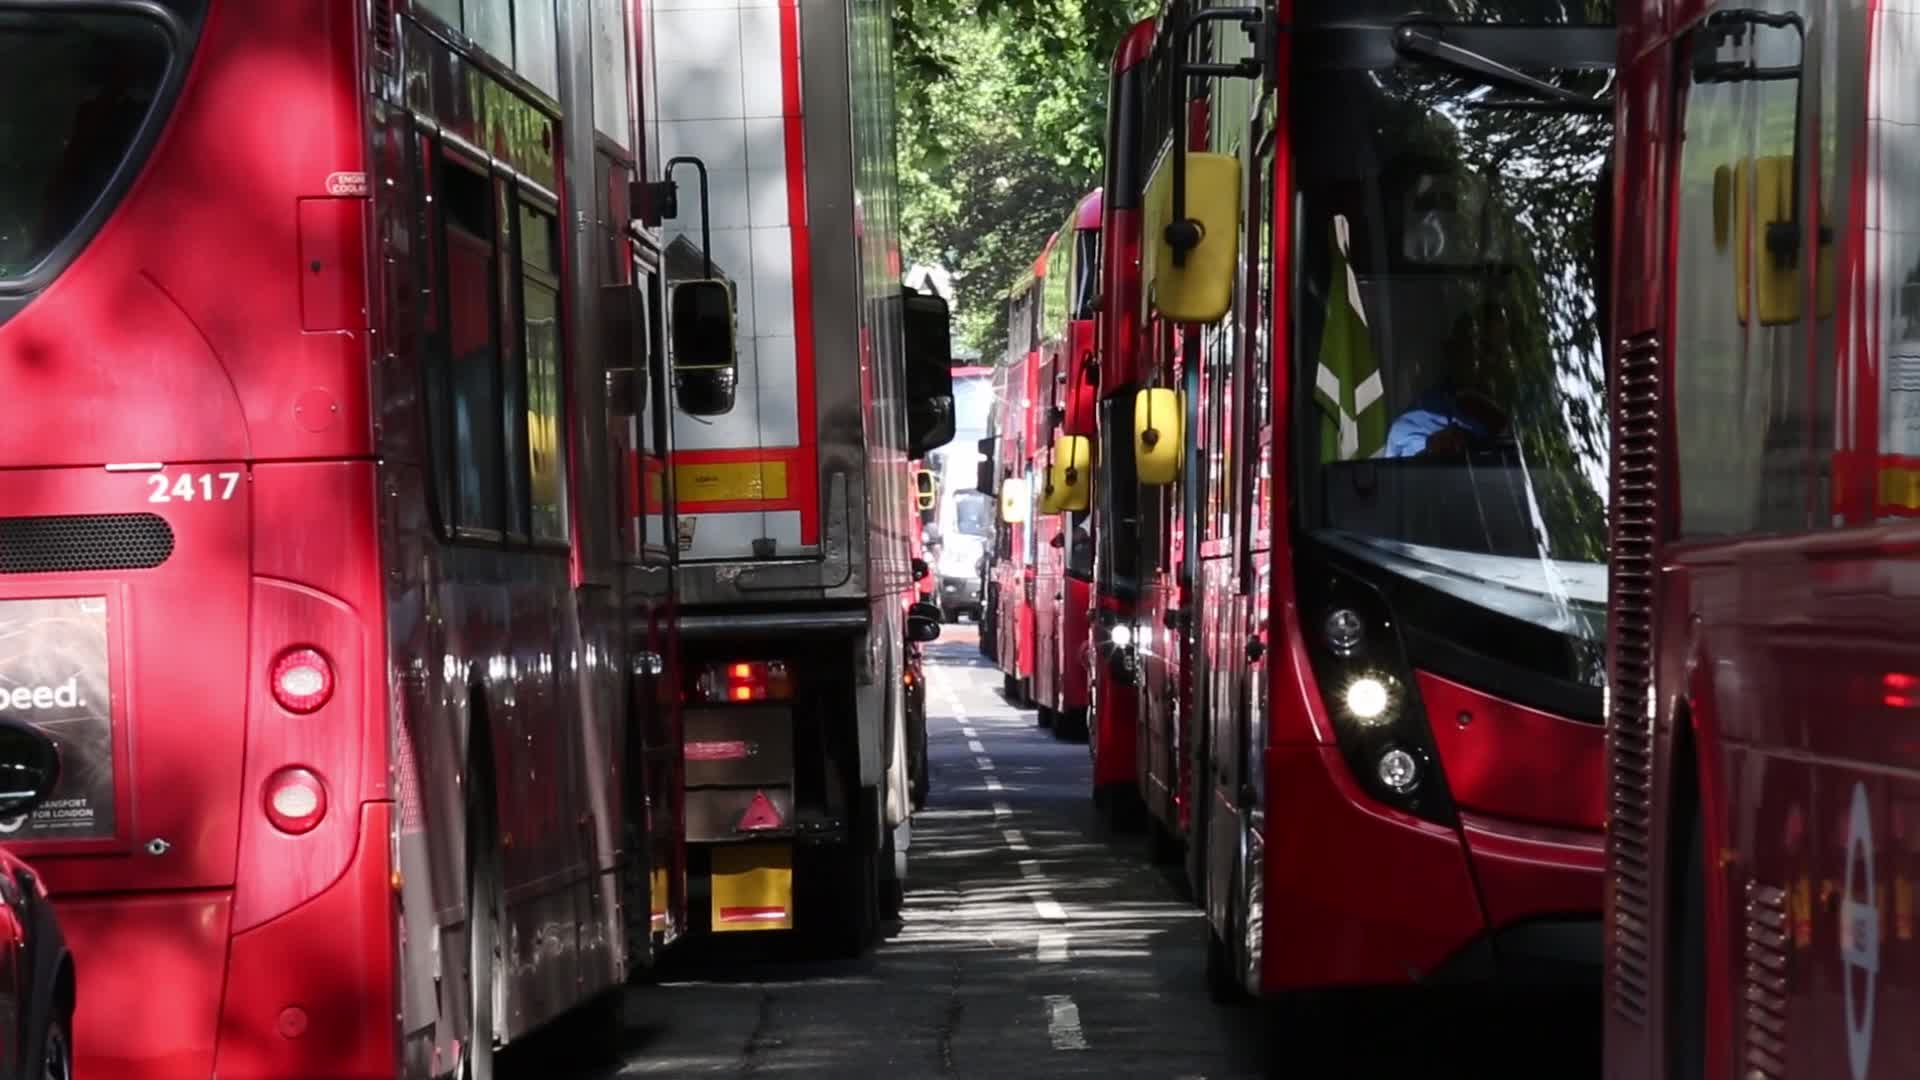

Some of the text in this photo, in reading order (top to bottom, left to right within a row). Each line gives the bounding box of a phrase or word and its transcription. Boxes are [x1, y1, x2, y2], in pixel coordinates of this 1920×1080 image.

[148, 472, 240, 503] 2417
[39, 798, 87, 808] ANSPORT
[52, 808, 94, 818] LONDON
